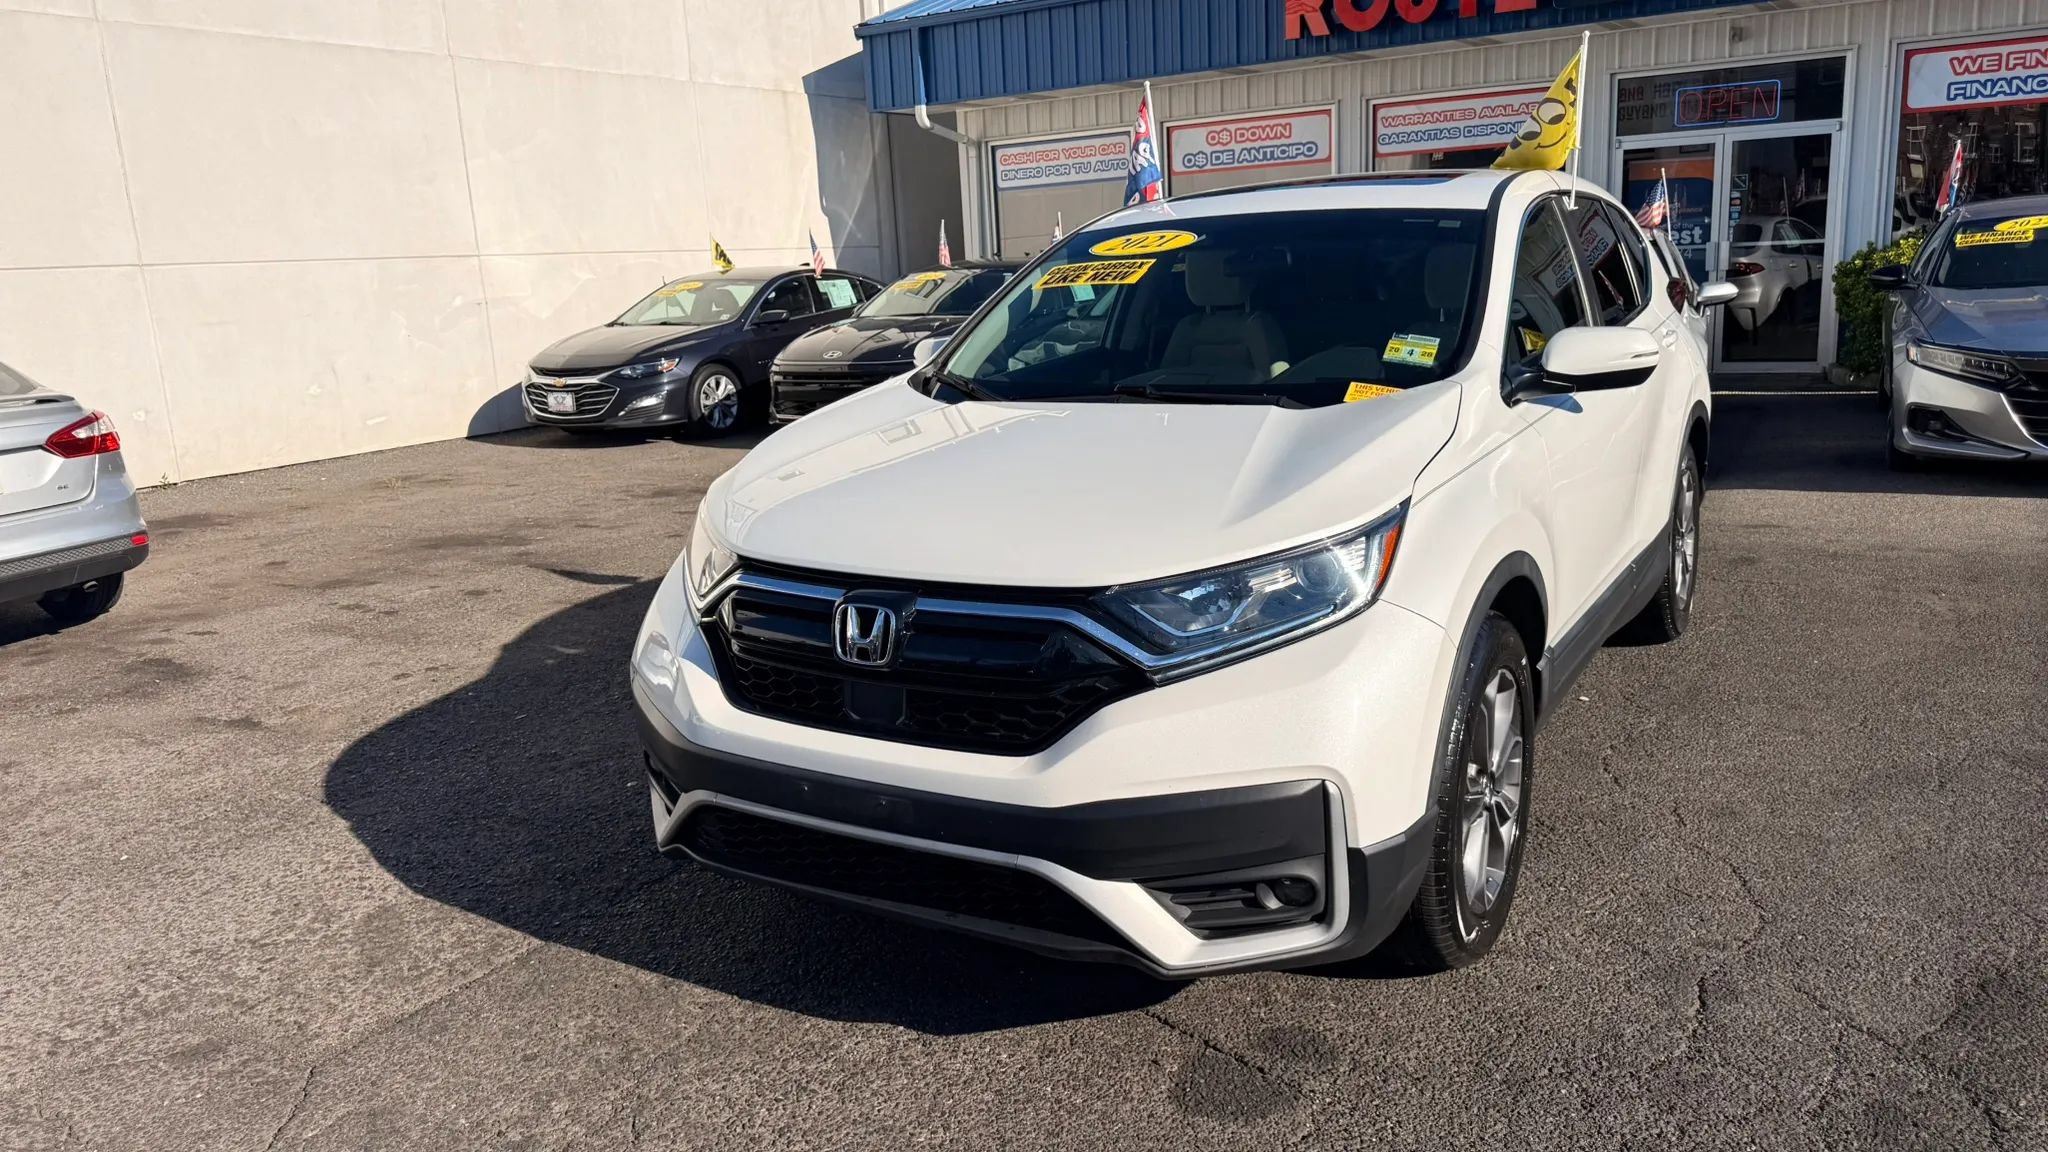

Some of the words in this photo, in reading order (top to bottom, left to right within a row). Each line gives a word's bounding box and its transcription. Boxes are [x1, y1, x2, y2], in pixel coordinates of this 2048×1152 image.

[1949, 52, 2002, 76] WE
[1679, 85, 1778, 122] OPEN
[1381, 107, 1476, 128] WARRANTIES
[1234, 122, 1292, 144] DOWN
[1378, 128, 1461, 145] GARANTIAS
[1000, 153, 1034, 166] CASH
[1035, 149, 1060, 164] FOR
[1062, 146, 1096, 160] YOUR
[1098, 142, 1126, 155] CAR
[1210, 151, 1235, 167] DE
[1236, 141, 1319, 164] ANTICIPO
[1000, 167, 1043, 182] DINERO
[1044, 164, 1071, 177] POR
[1072, 162, 1091, 174] TU
[1092, 158, 1130, 173] AUTO
[1104, 233, 1183, 252] 2021
[1671, 226, 1702, 244] est
[1979, 230, 2029, 238] FINANCE
[1039, 271, 1088, 286] LIKE
[1083, 270, 1137, 283] NEW
[1046, 263, 1093, 277] CLEAN
[1090, 260, 1153, 272] CARFAX
[1355, 383, 1373, 391] THIS
